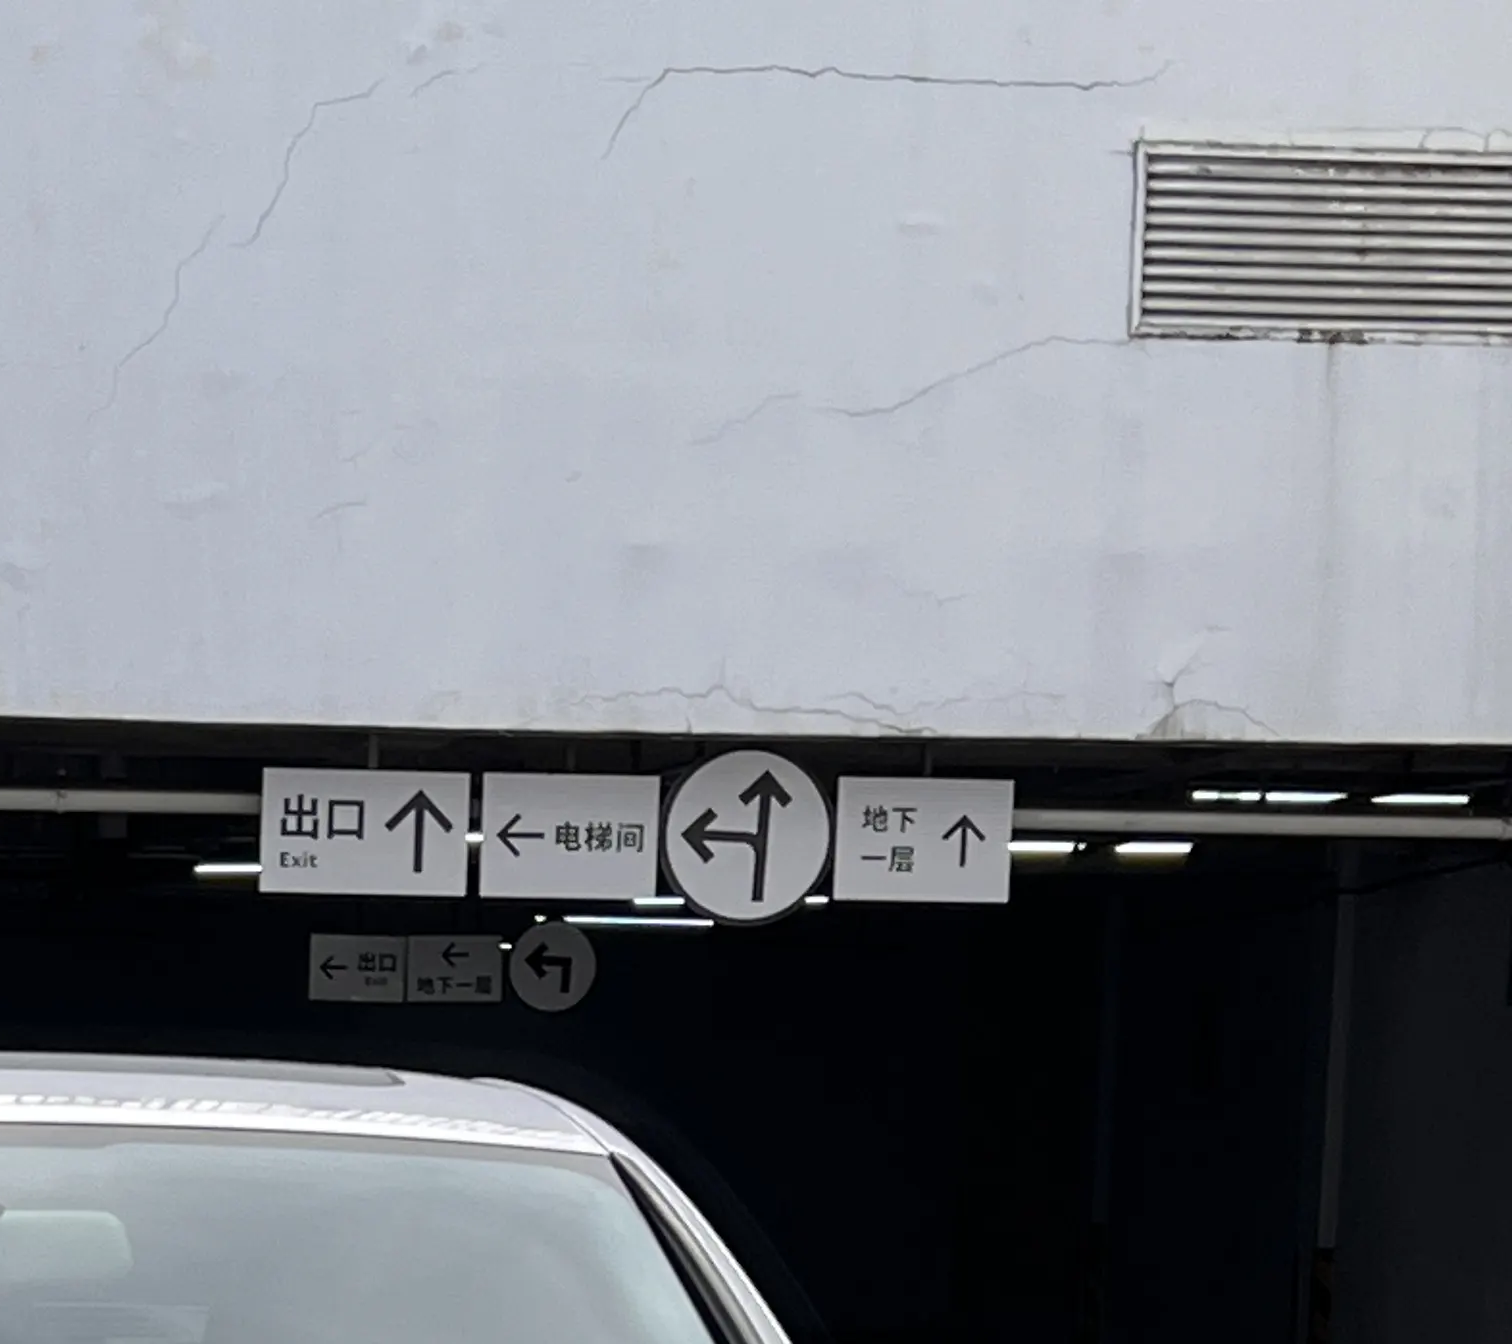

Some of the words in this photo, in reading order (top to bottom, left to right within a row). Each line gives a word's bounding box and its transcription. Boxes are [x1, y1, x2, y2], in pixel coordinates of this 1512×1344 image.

[280, 794, 365, 840] 出口
[862, 805, 917, 833] 地下
[555, 821, 645, 852] 电梯间
[279, 852, 318, 868] Exit
[861, 846, 915, 873] 一层
[357, 952, 397, 972] 出口
